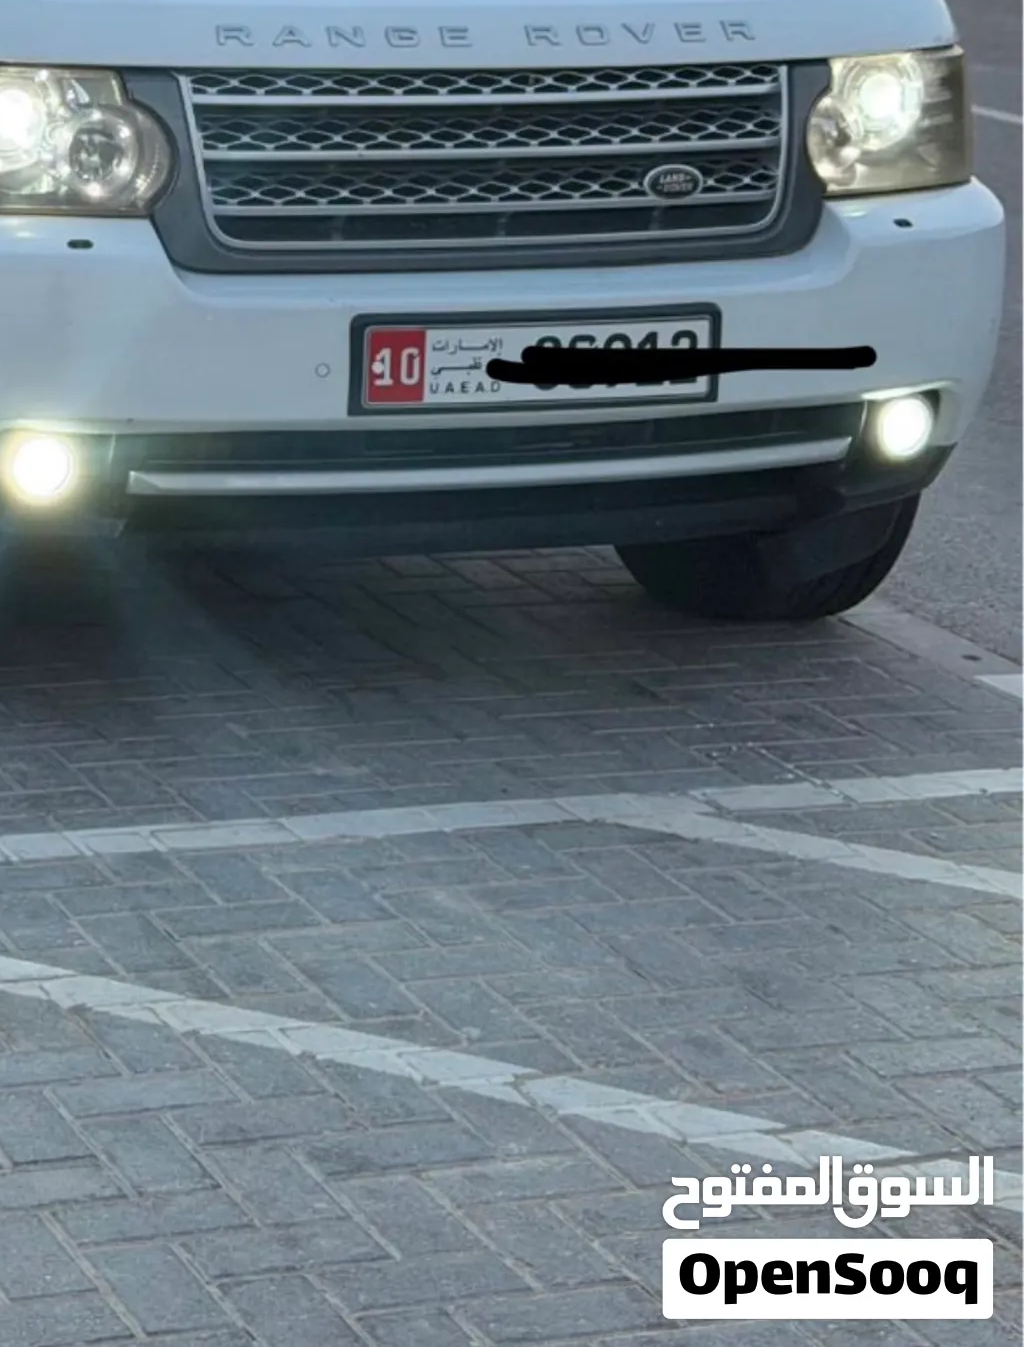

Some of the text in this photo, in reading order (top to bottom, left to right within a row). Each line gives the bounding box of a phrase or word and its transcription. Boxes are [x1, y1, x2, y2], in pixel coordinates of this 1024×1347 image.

[215, 20, 756, 48] RANGE ROVER
[372, 347, 420, 386] 10
